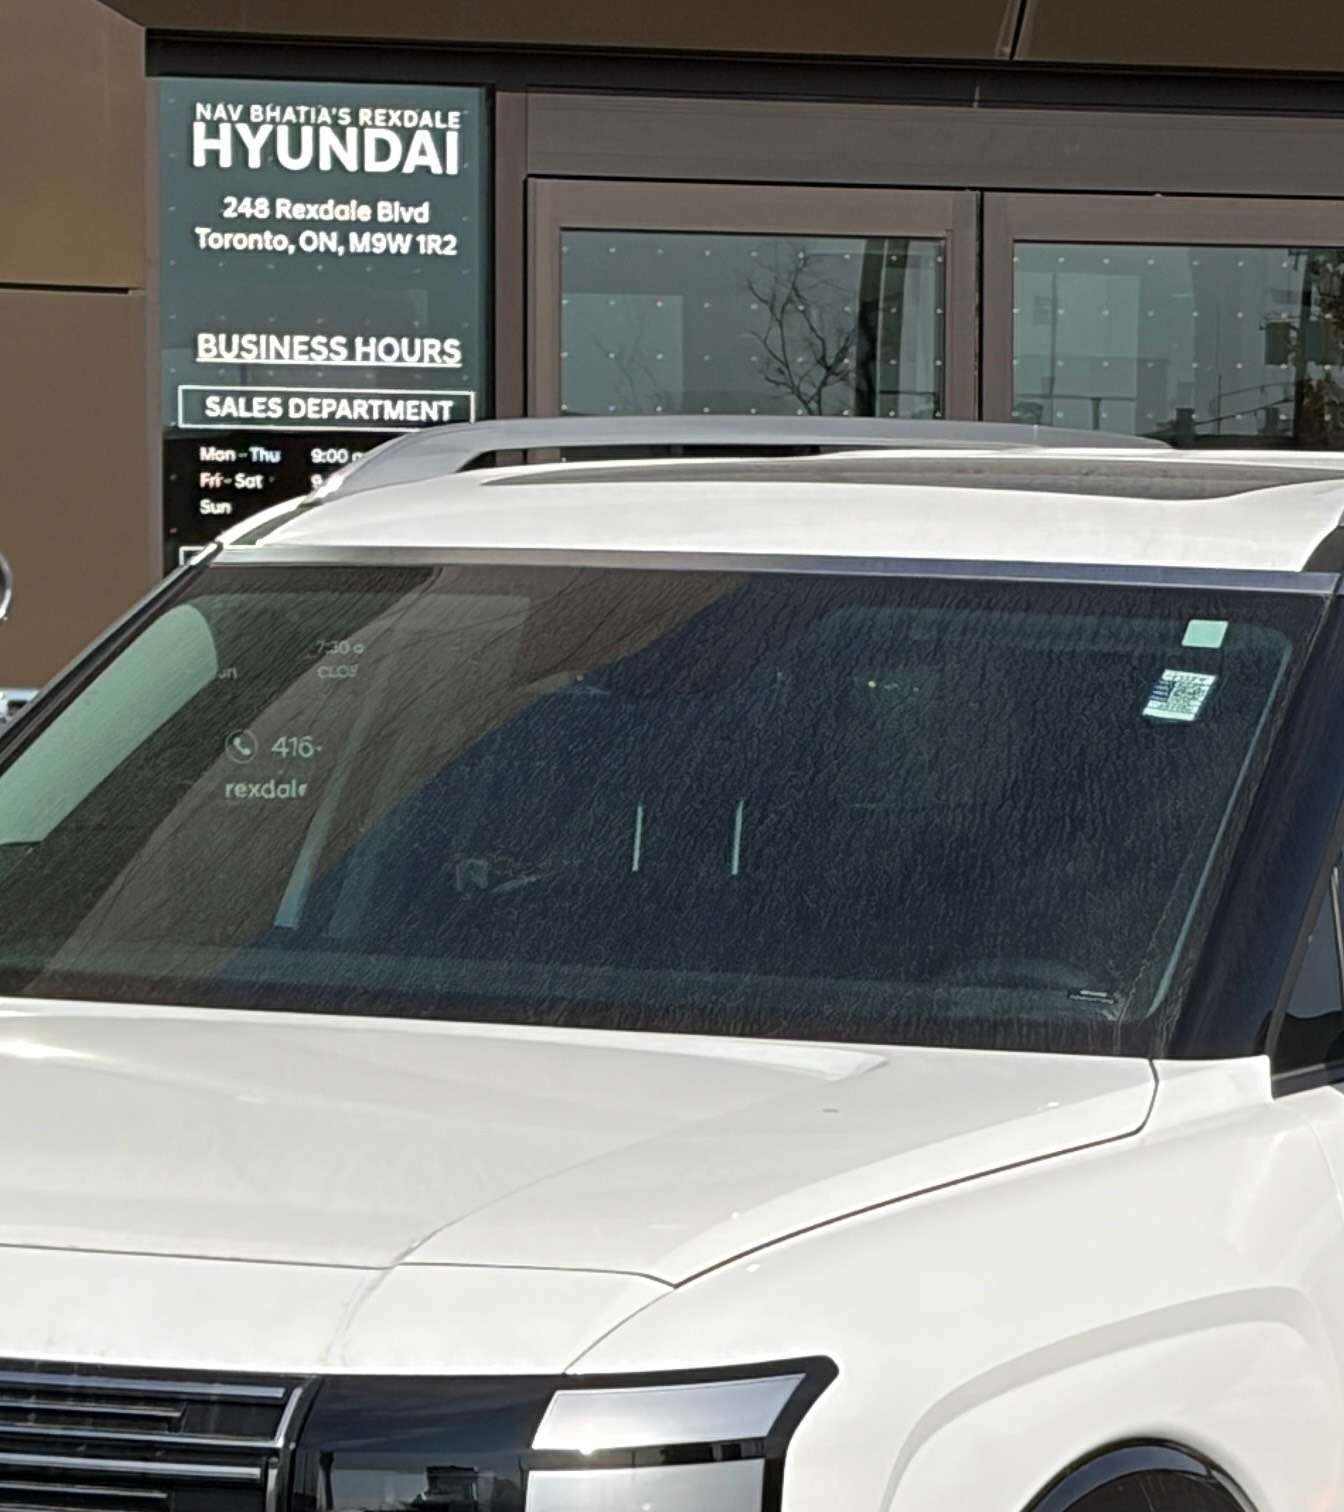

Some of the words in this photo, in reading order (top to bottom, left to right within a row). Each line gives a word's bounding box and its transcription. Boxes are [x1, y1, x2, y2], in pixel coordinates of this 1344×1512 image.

[195, 102, 243, 121] NAV
[249, 104, 351, 125] BHATIA'S
[358, 108, 462, 129] REXDALE
[192, 121, 459, 176] HYUNDAI
[222, 196, 270, 219] 248
[274, 198, 372, 222] Rexdale
[376, 201, 430, 223] Blvd
[194, 227, 295, 255] Toronto,
[298, 230, 345, 256] ON,
[348, 232, 412, 254] M9W
[415, 234, 458, 256] 1R2
[197, 333, 348, 362] BUSINESS
[354, 336, 463, 365] HOURS
[205, 395, 284, 418] SALES
[287, 397, 454, 422] DEPARTMENT
[199, 446, 236, 462] Mon
[249, 447, 281, 463] Thu
[310, 448, 349, 464] 9:00
[234, 473, 264, 489] Sat
[199, 499, 232, 514] Sun
